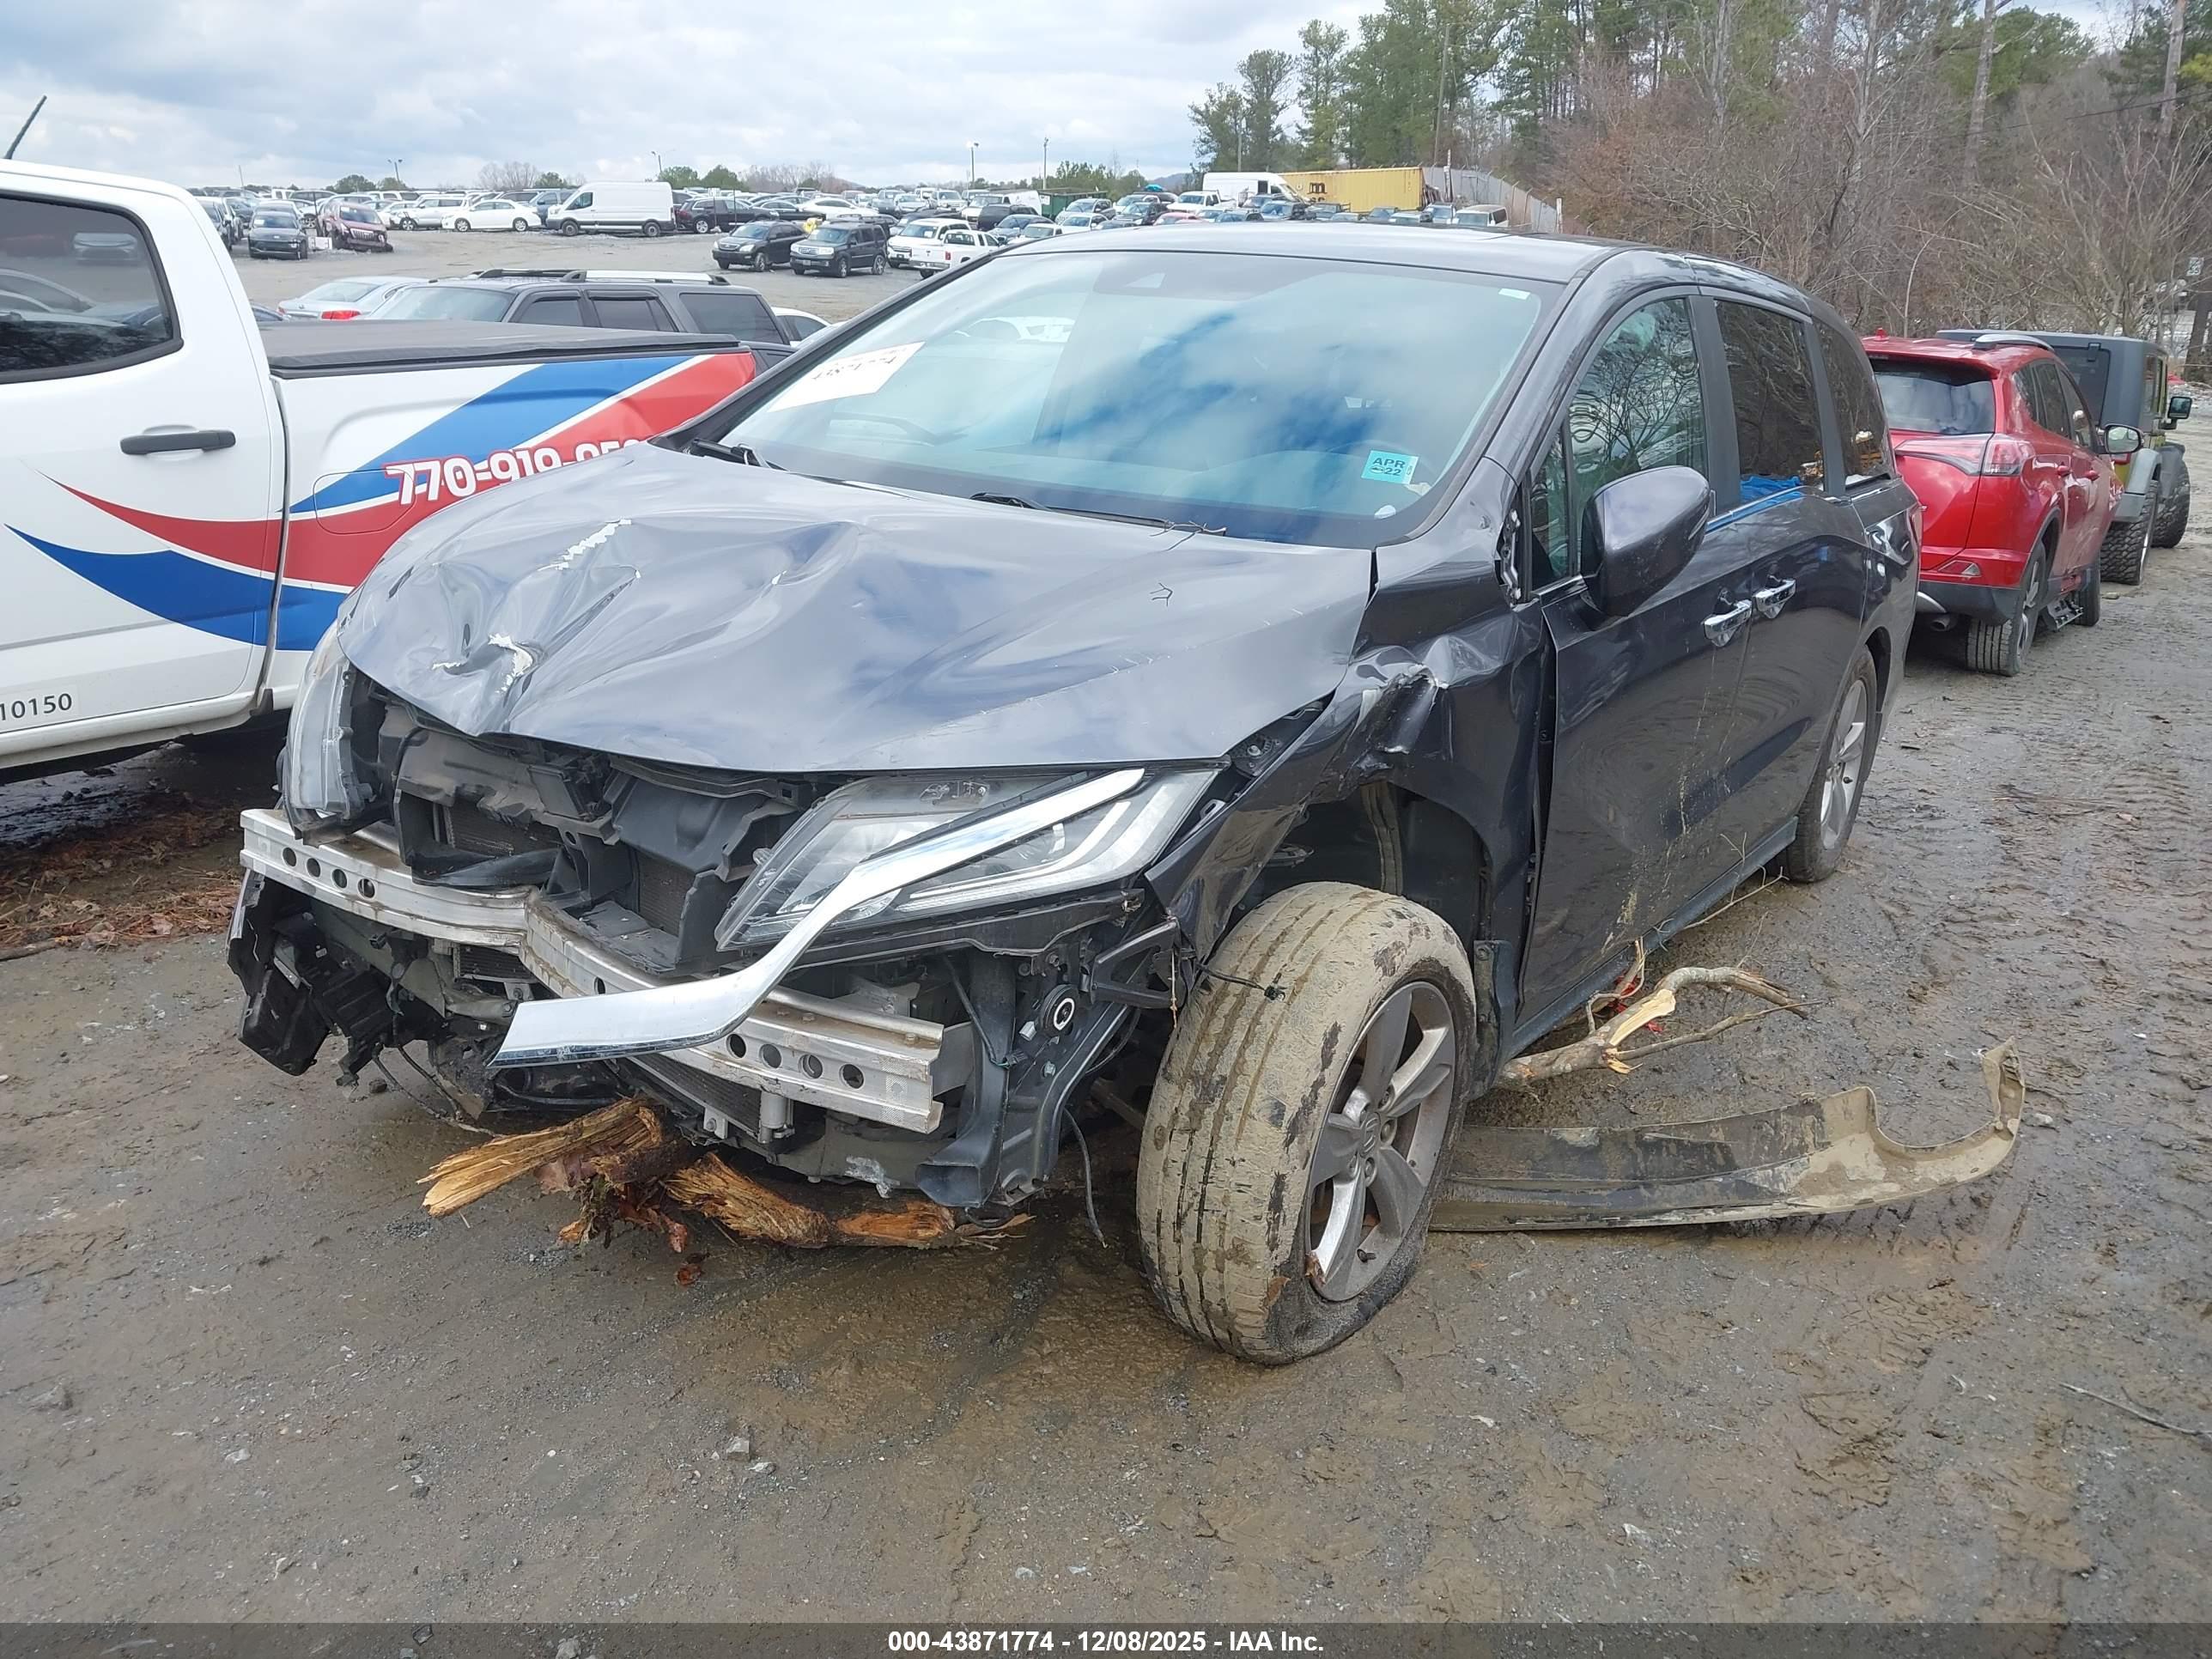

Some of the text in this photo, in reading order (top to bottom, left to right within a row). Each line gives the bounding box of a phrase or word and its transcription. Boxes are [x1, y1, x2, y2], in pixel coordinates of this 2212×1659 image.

[1373, 458, 1406, 468] APR
[1384, 467, 1402, 477] 22
[0, 693, 72, 720] 10150
